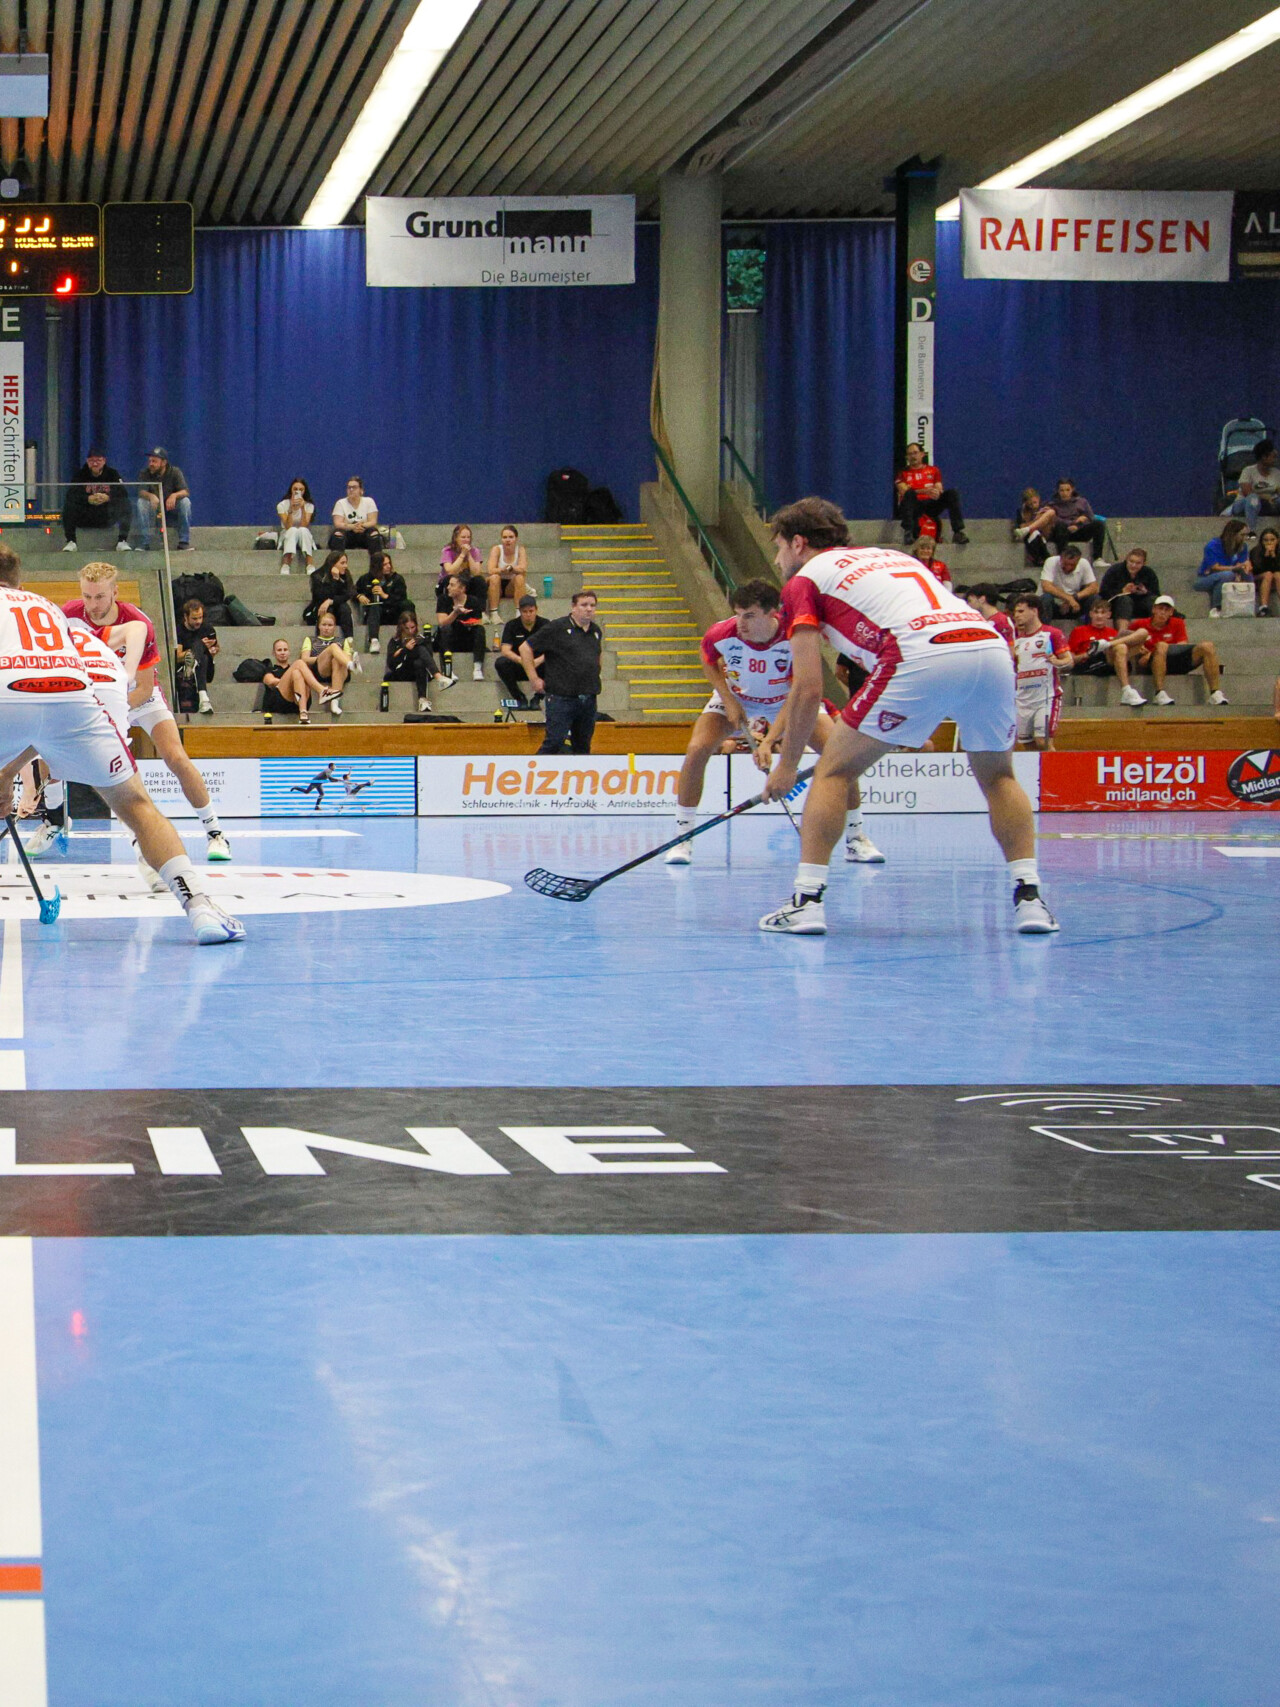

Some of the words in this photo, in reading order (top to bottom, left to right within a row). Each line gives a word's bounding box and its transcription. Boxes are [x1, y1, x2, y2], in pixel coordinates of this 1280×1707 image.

[980, 217, 1210, 253] RAIFFEISEN
[481, 270, 505, 284] Die
[510, 269, 592, 284] Baumeister
[2, 307, 20, 331] E
[911, 297, 932, 322] D
[889, 571, 942, 610] 7
[10, 606, 64, 652] 19
[748, 658, 766, 673] 80
[462, 760, 681, 796] Heizmann
[863, 758, 974, 778] othekarba
[1097, 756, 1205, 784] Heizöl
[607, 799, 677, 808] Antriebstechni
[860, 786, 917, 809] zburg
[1106, 787, 1196, 801] midland.ch
